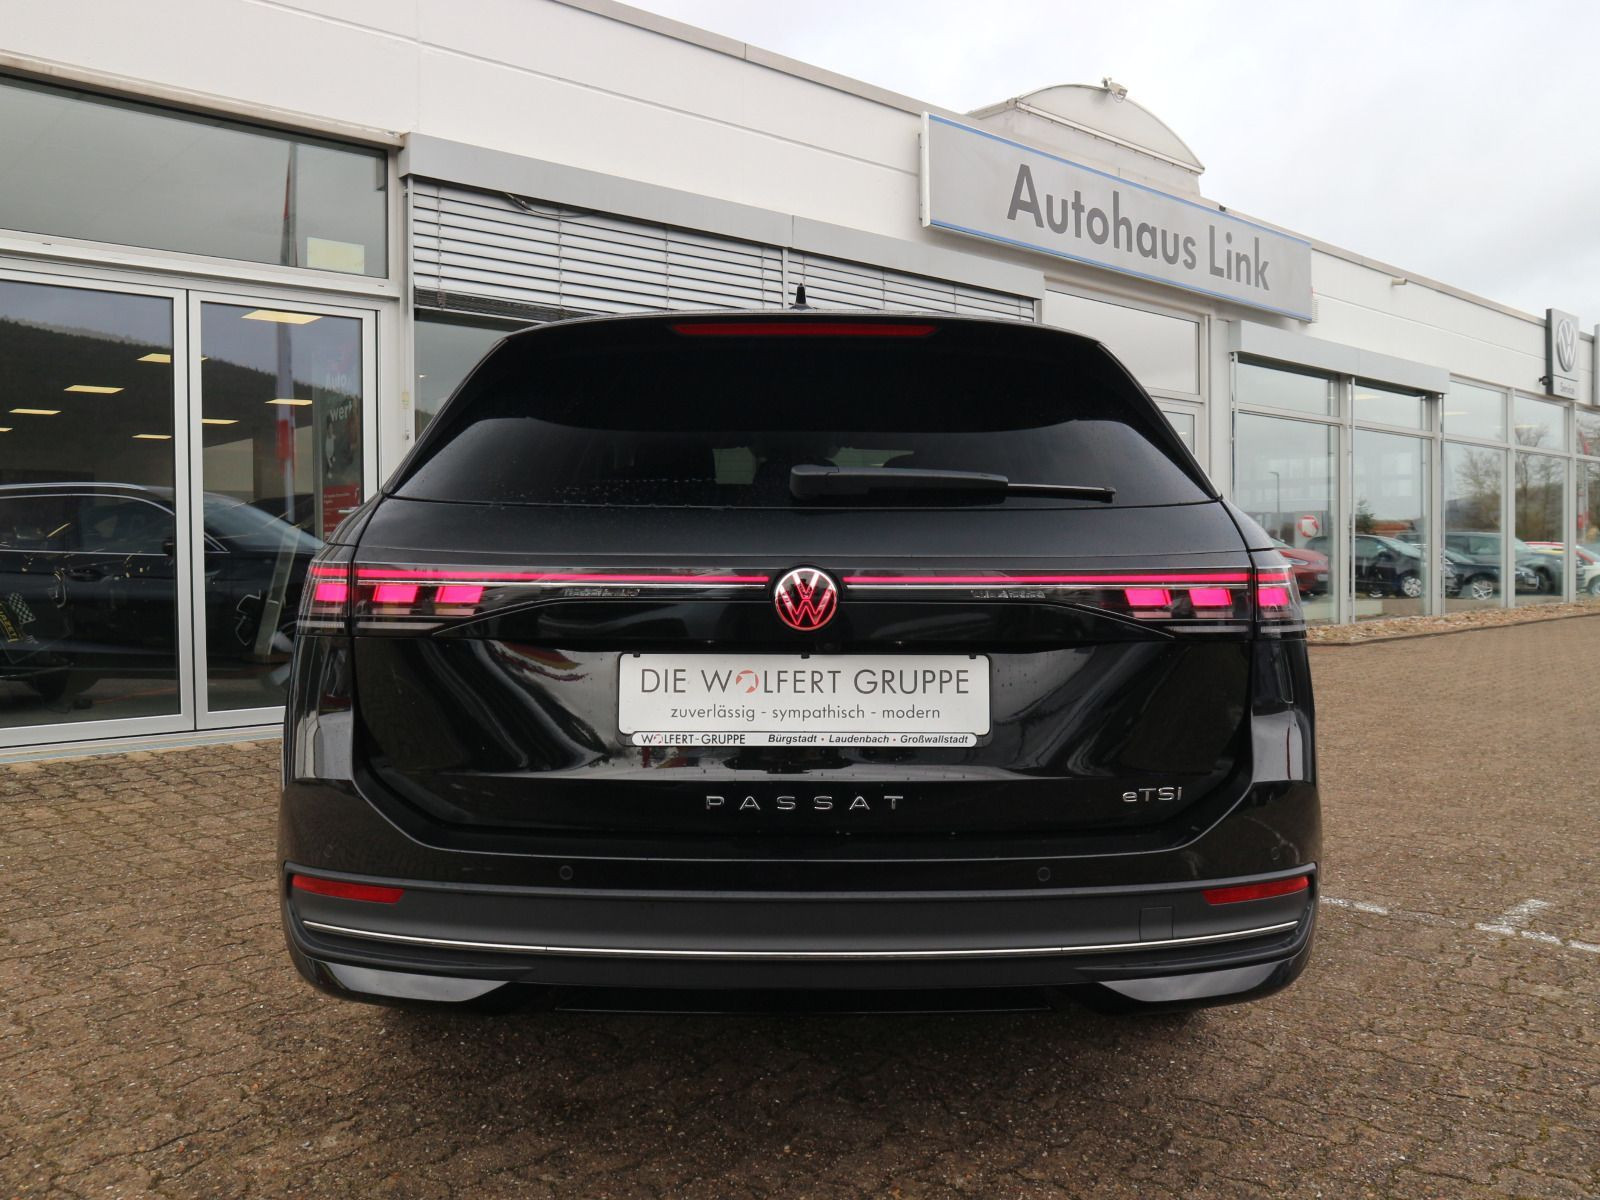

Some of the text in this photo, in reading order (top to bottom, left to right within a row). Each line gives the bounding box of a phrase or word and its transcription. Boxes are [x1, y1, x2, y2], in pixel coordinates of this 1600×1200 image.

[1007, 163, 1270, 291] Autohaus Link
[641, 668, 970, 694] DIE WOLFERT GRUPPE
[670, 703, 756, 722] zuverlässig
[772, 703, 865, 722] sympathisch
[881, 704, 941, 720] modern
[768, 734, 969, 745] Bürgstadt Laudenbach Großwallstadt
[706, 795, 904, 811] PASSAT
